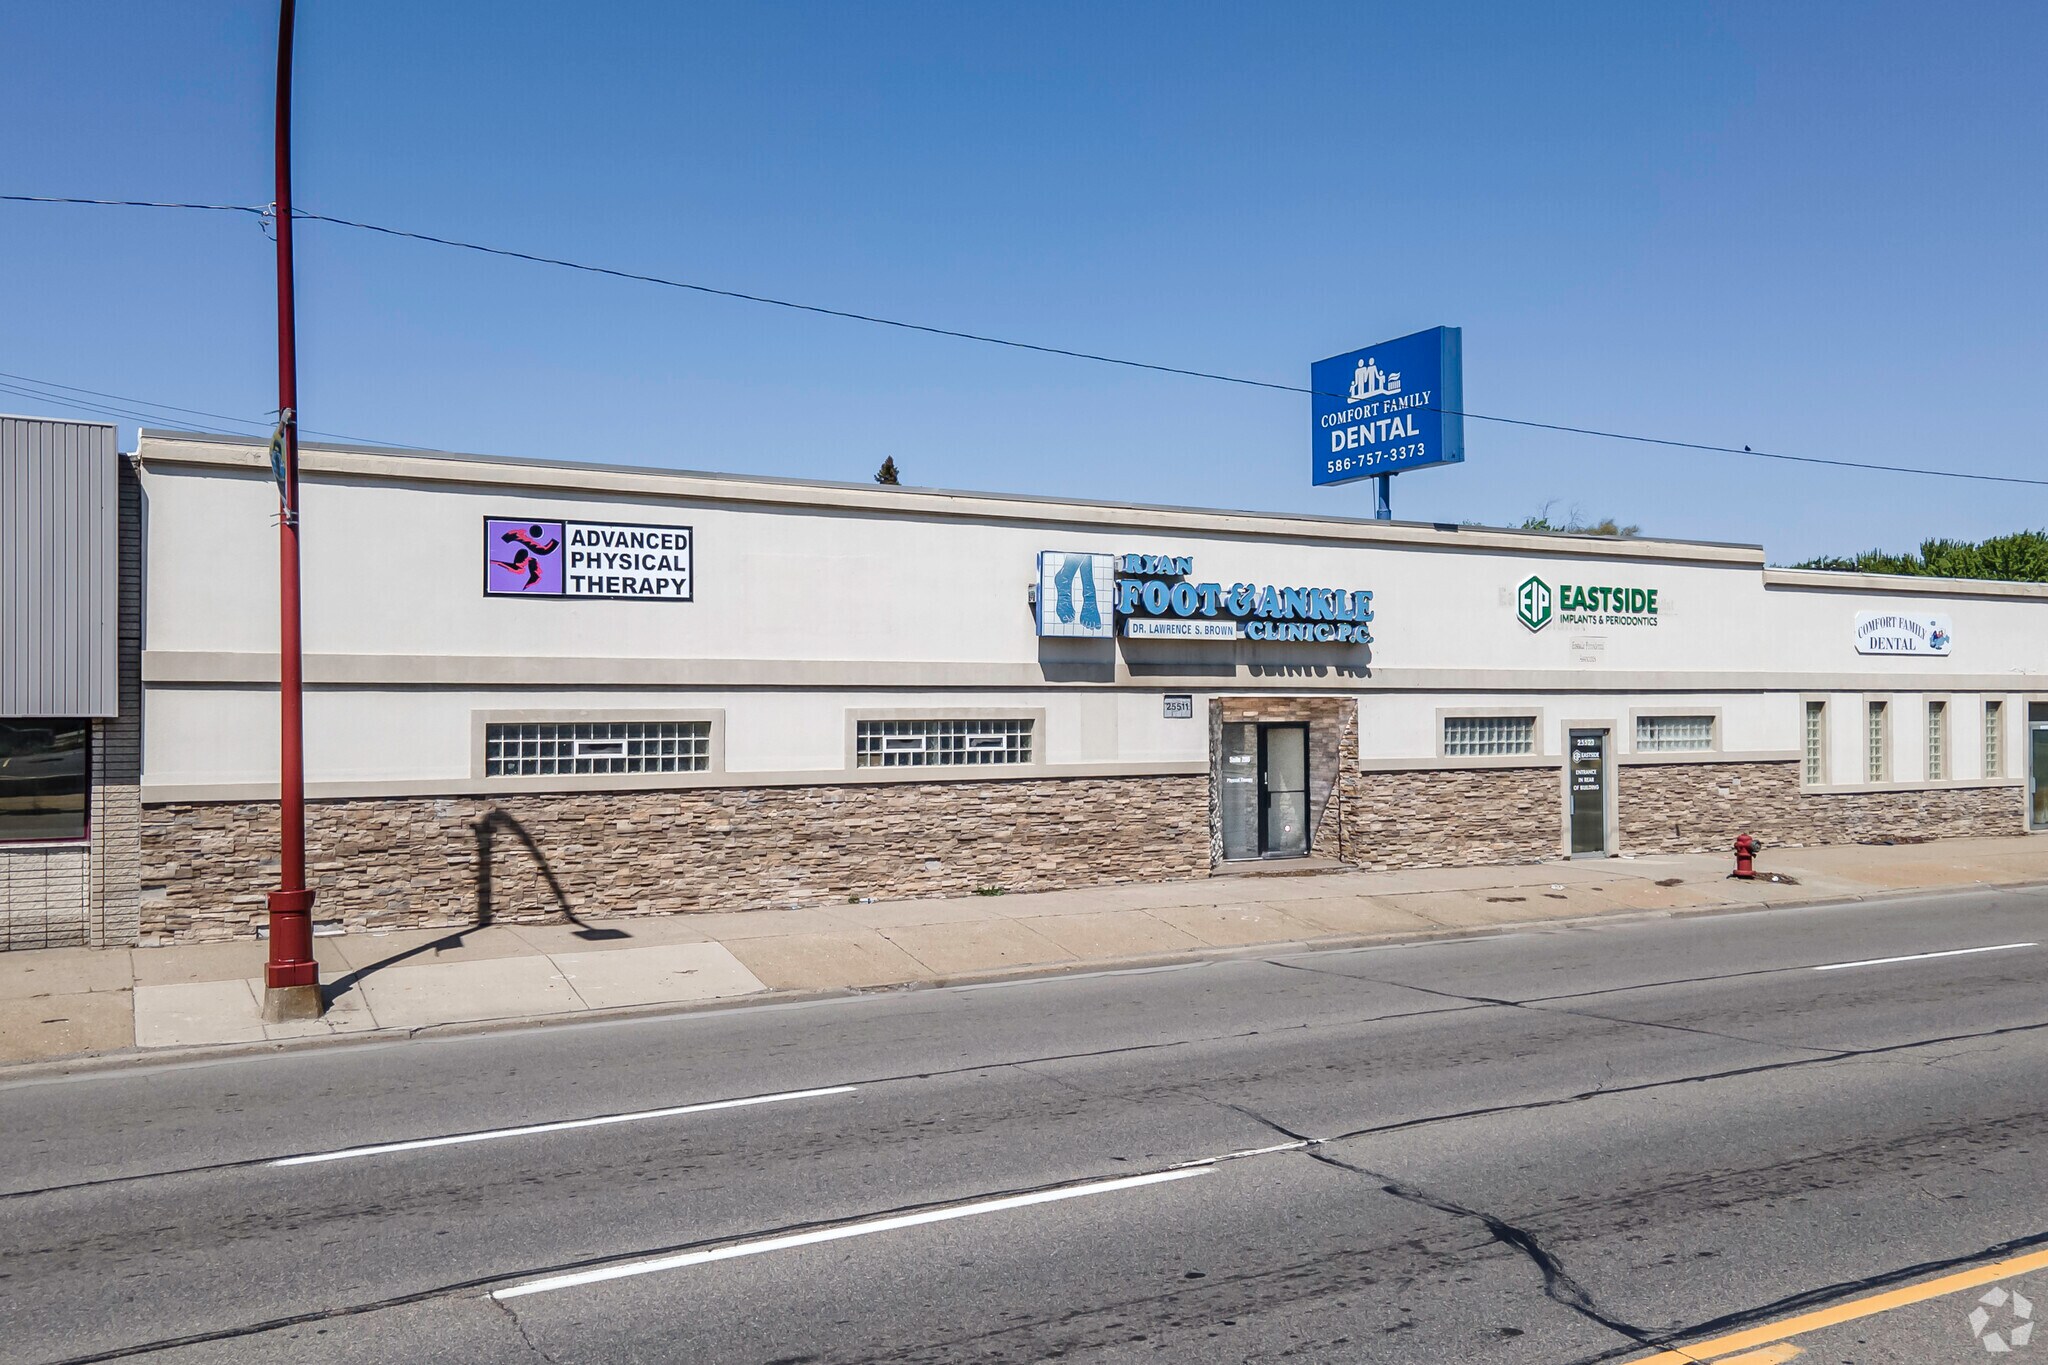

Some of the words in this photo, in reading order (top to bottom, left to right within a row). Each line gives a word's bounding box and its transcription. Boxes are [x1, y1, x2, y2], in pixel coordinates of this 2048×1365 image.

[1321, 402, 1379, 428] COMFORT
[1383, 390, 1431, 414] FAMILY
[1331, 413, 1420, 453] DENTAL
[1327, 442, 1425, 474] 586-757-3373
[570, 529, 688, 551] ADVANCED
[570, 551, 686, 572] PHYSICAL
[1120, 553, 1193, 575] RYAN
[570, 575, 687, 595] THERAPY
[1559, 585, 1659, 614] EASTSIDE
[1133, 623, 1147, 634] DR.
[1149, 624, 1192, 635] LAWRENCE
[1194, 624, 1203, 635] S.
[1204, 625, 1233, 636] BROWN
[1560, 614, 1597, 625] IMPLANTS
[1598, 615, 1604, 625] &
[1605, 616, 1658, 627] PERIODONTICS
[1858, 616, 1897, 639] COMFORT
[1899, 617, 1927, 640] FAMILY
[1245, 620, 1331, 643] CLINIC
[1334, 622, 1375, 644] P.C.
[1870, 637, 1917, 651] DENTAL
[1166, 702, 1190, 711] 25511
